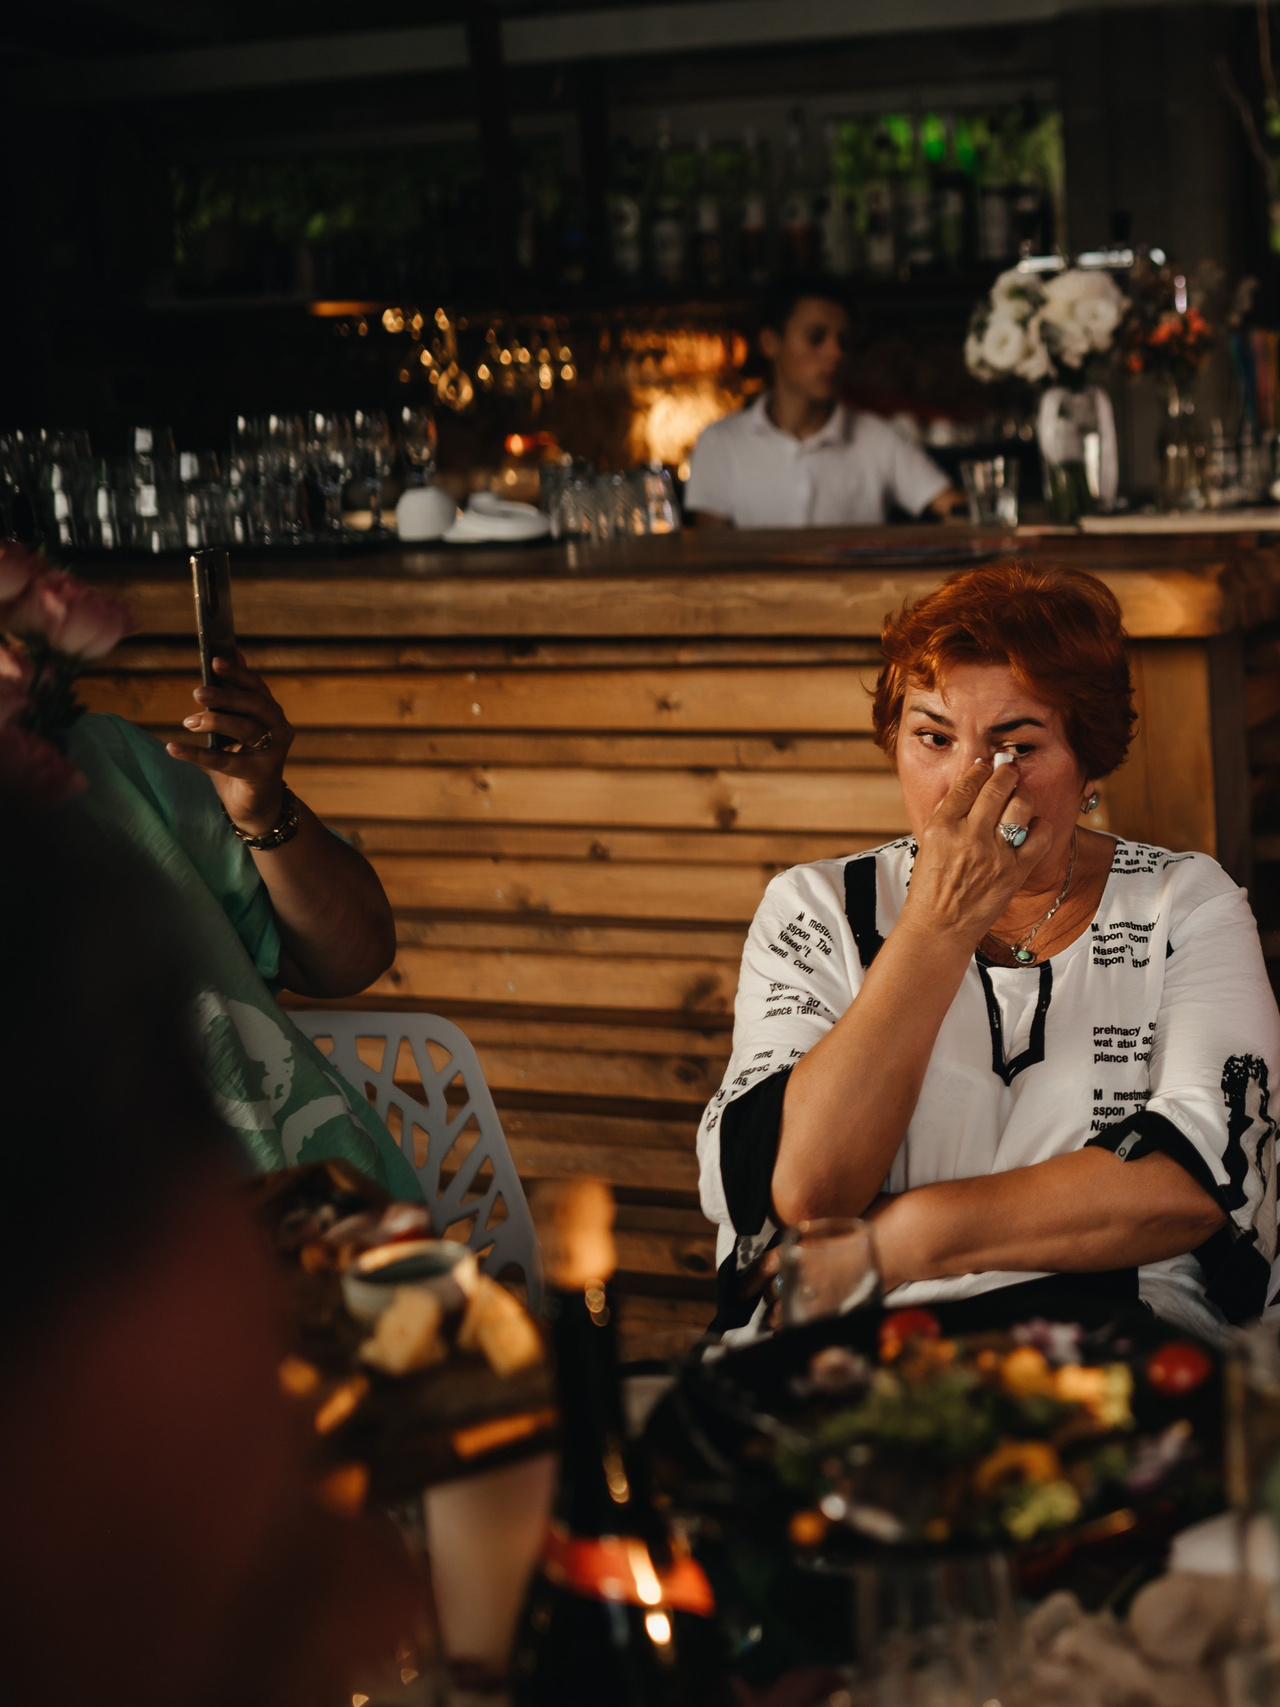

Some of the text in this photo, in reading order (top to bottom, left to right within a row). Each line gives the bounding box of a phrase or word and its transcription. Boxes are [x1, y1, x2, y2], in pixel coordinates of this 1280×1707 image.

[1091, 922, 1100, 932] M
[786, 922, 832, 956] sspon The
[1128, 933, 1148, 943] com
[793, 959, 815, 975] com
[1093, 955, 1125, 968] sspon
[1093, 1025, 1141, 1037] prehnacy
[1093, 1038, 1113, 1048] wat
[1094, 1051, 1129, 1064] plance
[1093, 1088, 1103, 1101] M
[1093, 1106, 1125, 1119] sspon
